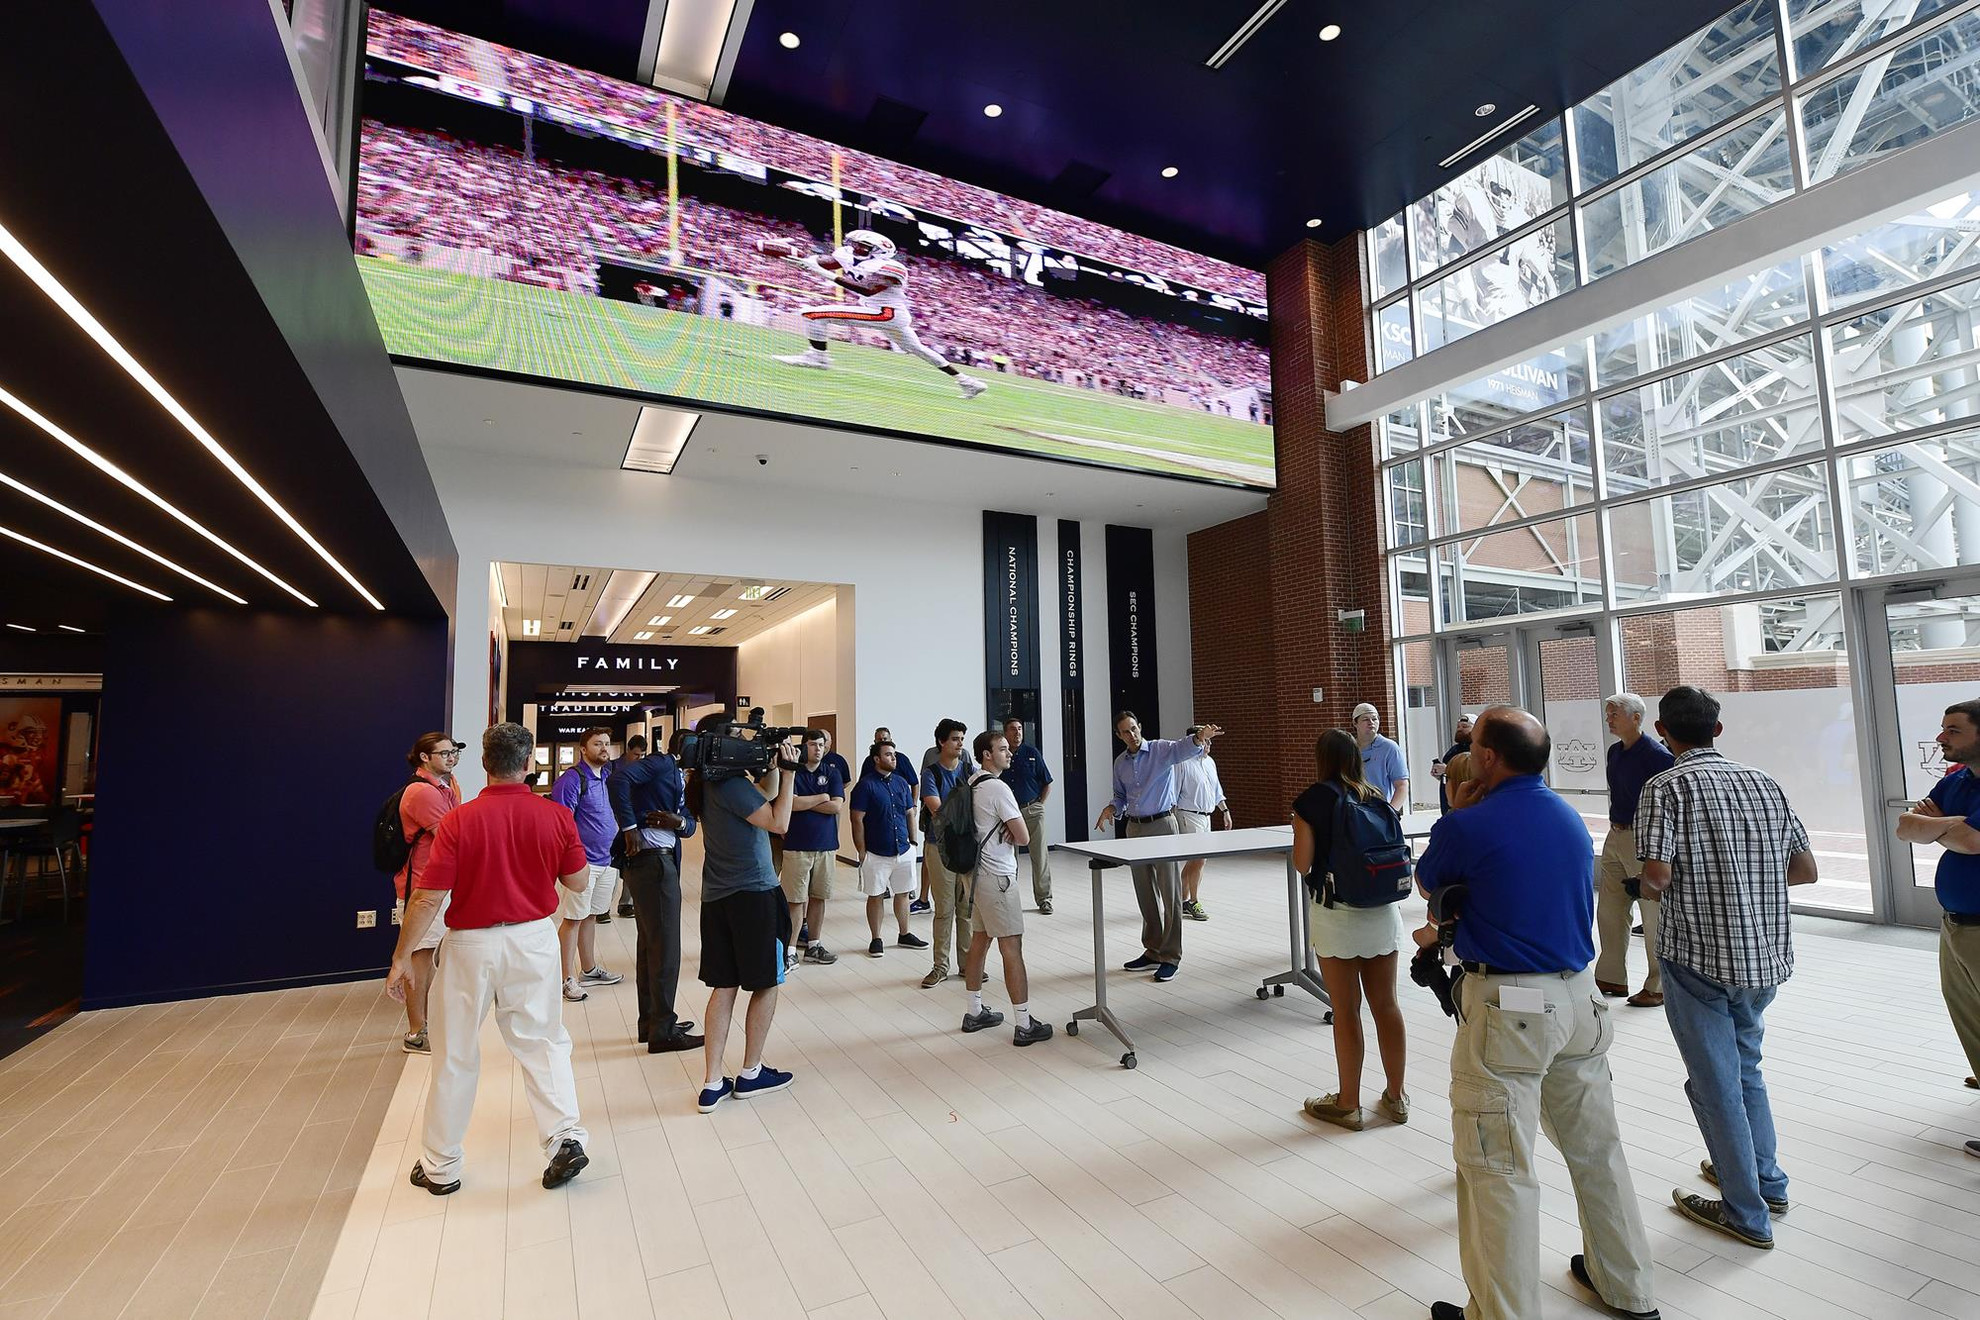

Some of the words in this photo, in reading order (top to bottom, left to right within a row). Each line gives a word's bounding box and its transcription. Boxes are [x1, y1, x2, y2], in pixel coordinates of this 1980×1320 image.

[1487, 379, 1504, 392] 1971
[1506, 384, 1539, 401] HEISMAN
[1008, 546, 1017, 604] NATIONAL
[1066, 550, 1076, 639] CHAMPIONSHIP
[1129, 591, 1137, 612] SEC
[577, 656, 679, 670] FAMILY
[1009, 606, 1018, 676] CHAMPIONS
[1069, 641, 1077, 677] RINGS
[1130, 614, 1139, 678] CHAMPIONS
